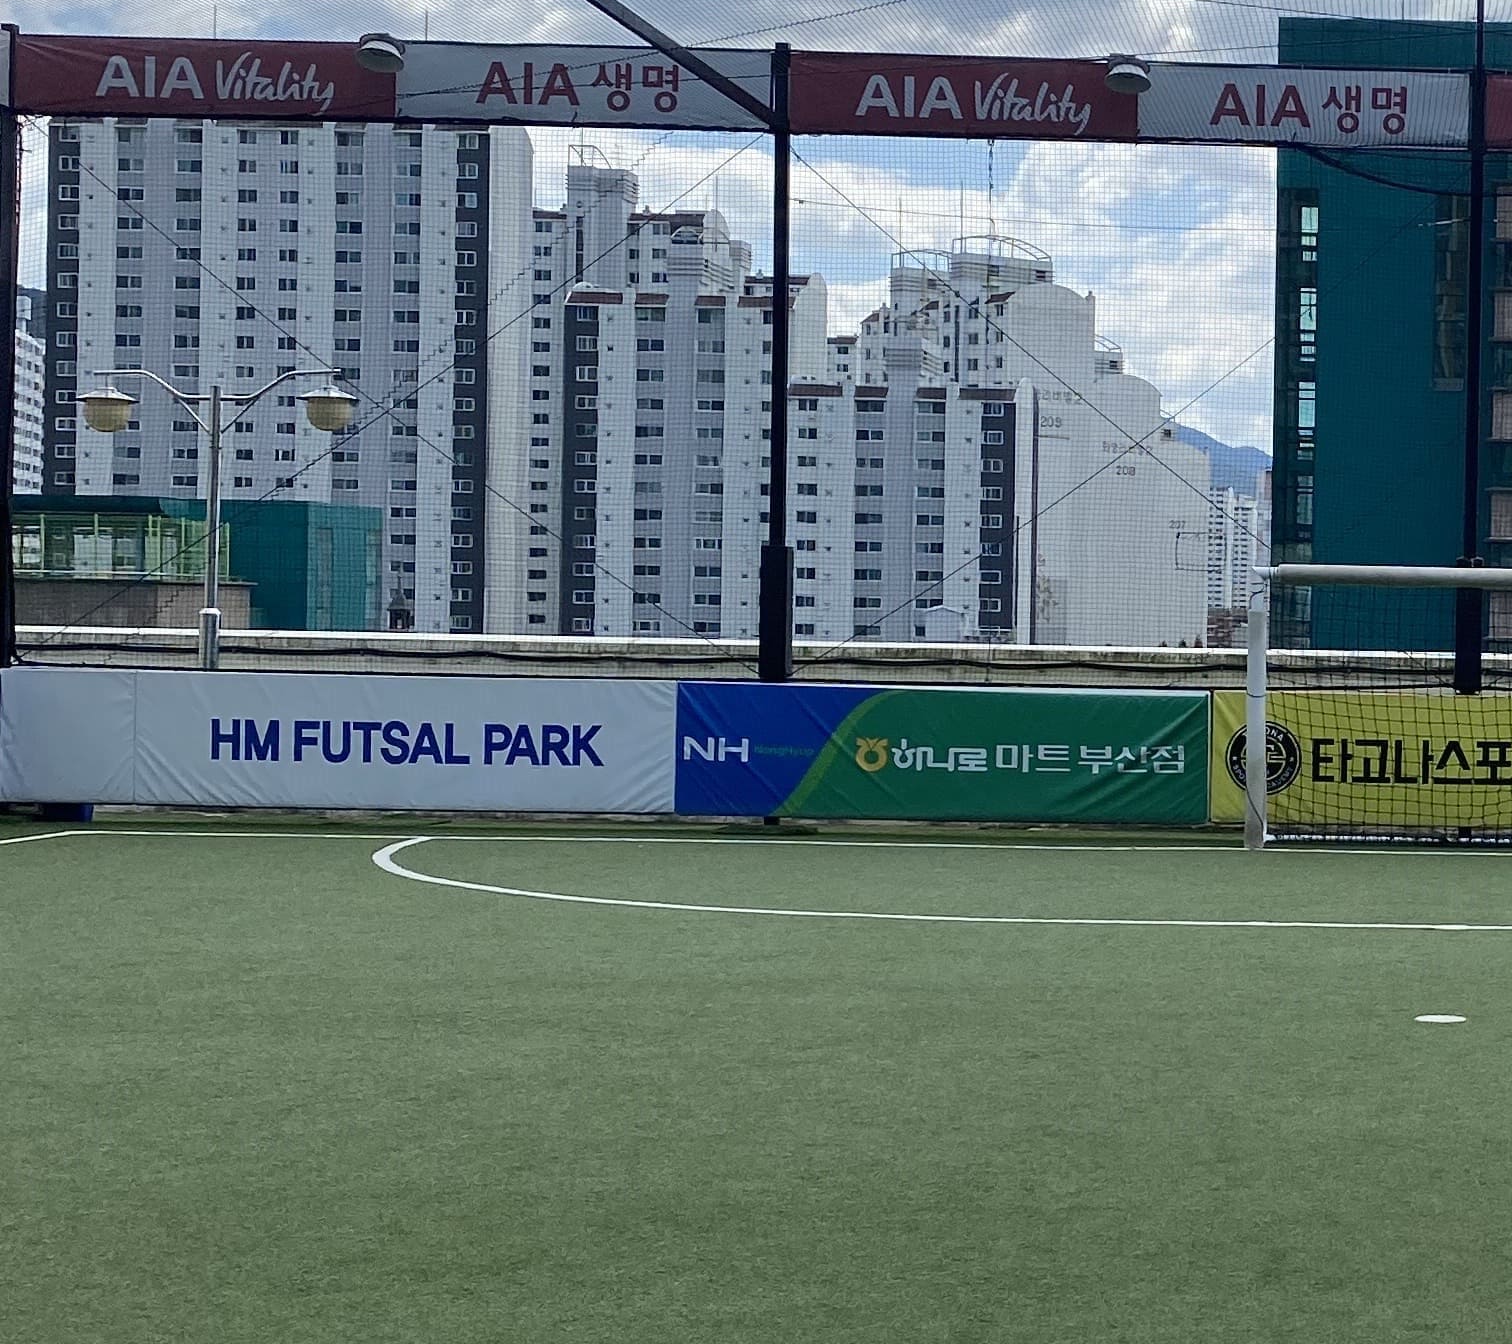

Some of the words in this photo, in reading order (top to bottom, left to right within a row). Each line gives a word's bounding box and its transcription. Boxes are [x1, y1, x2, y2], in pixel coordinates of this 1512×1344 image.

[96, 55, 205, 100] AIA
[215, 50, 336, 115] Vitality
[476, 61, 582, 107] AIA
[590, 61, 680, 113] 생명
[855, 74, 964, 120] AIA
[973, 71, 1092, 135] Vitality
[1210, 83, 1311, 129] AIA
[1321, 83, 1408, 135] 생명
[210, 719, 280, 762] HM
[293, 721, 472, 767] FUTSAL
[483, 723, 606, 768] PARK
[683, 735, 749, 763] NH
